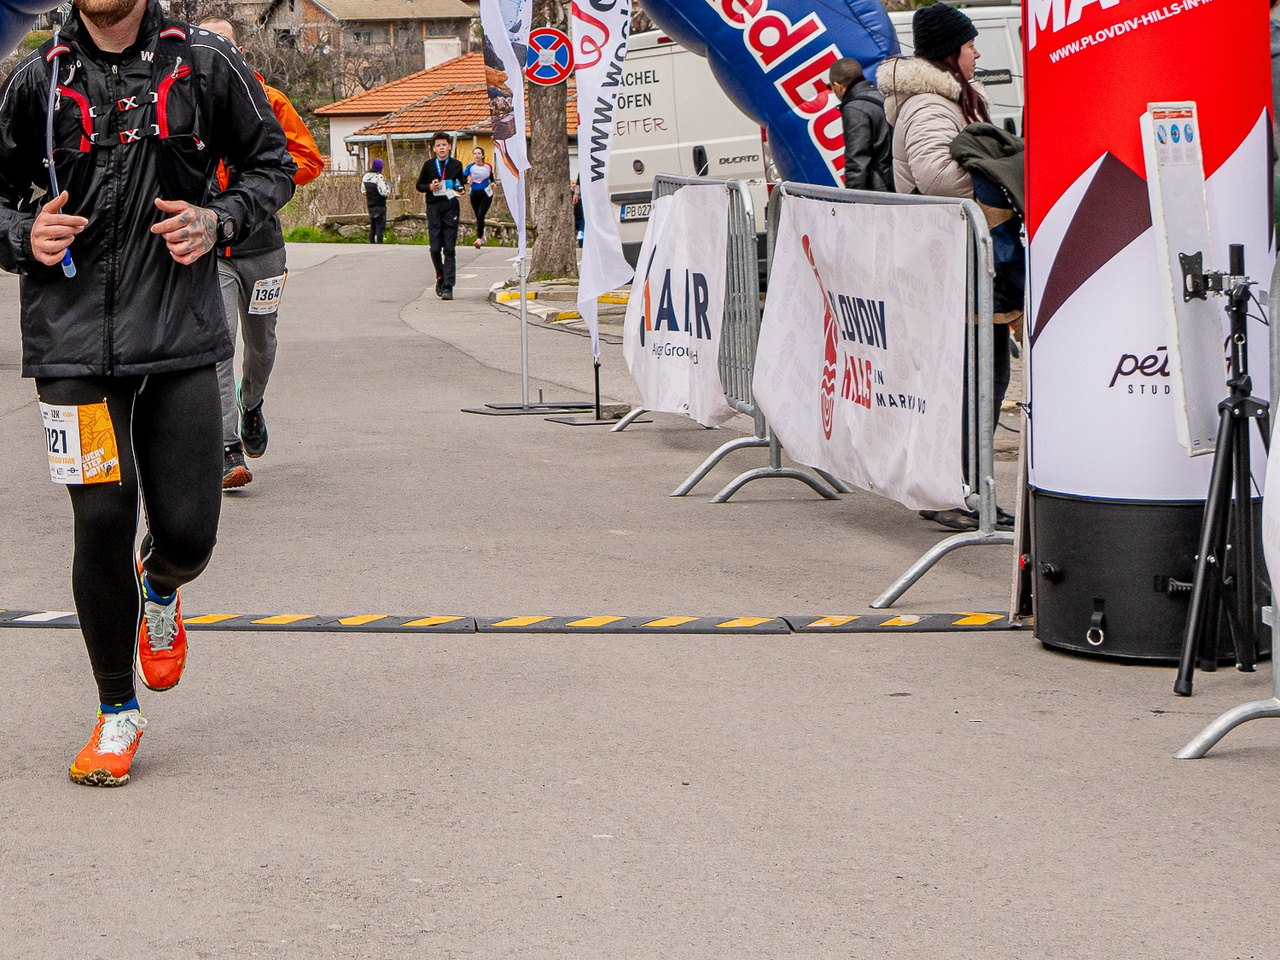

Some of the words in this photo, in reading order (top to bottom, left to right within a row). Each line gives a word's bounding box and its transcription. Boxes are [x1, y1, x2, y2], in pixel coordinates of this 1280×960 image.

[619, 70, 660, 87] ACHEL
[719, 154, 759, 165] DUCATO
[625, 204, 636, 217] PB
[637, 204, 652, 216] 027
[255, 286, 280, 301] 1364
[874, 369, 885, 385] IN
[1127, 384, 1171, 394] STUD
